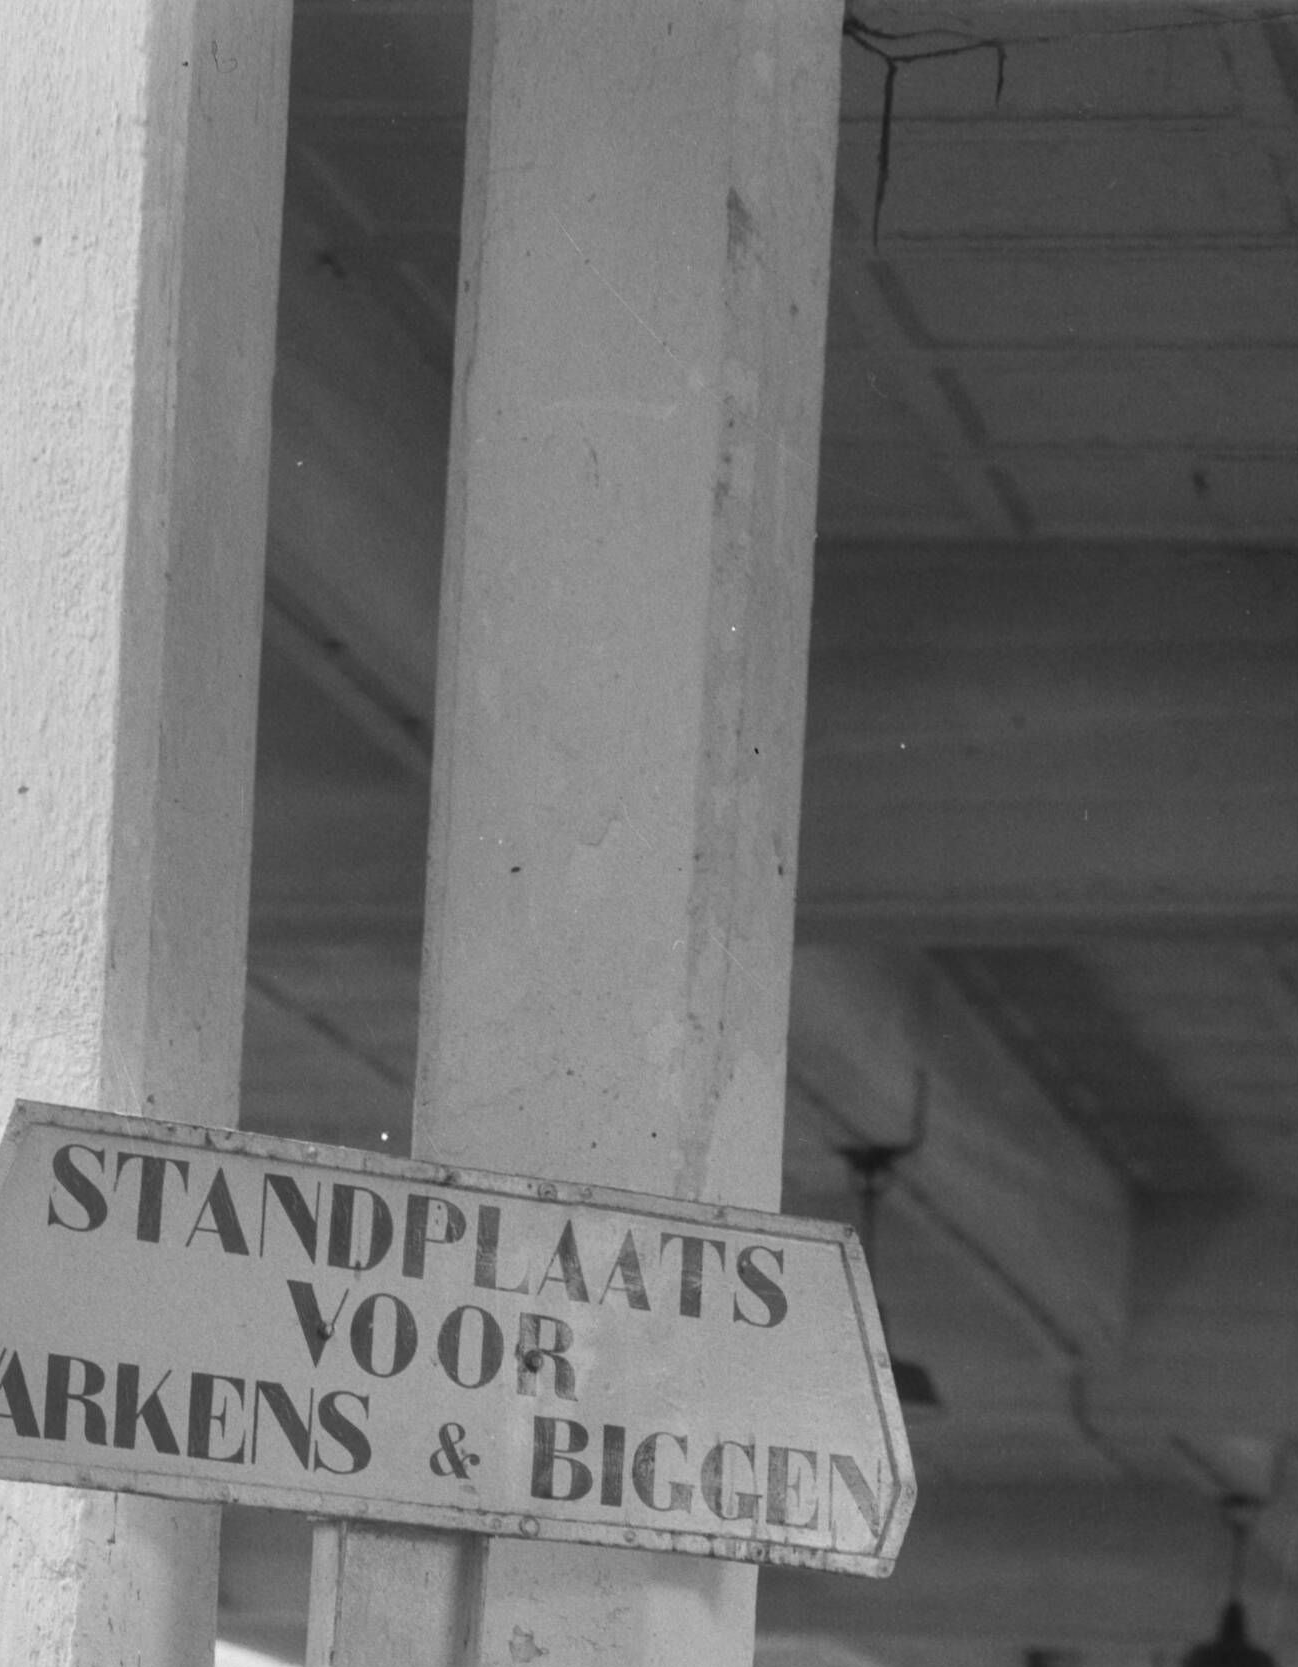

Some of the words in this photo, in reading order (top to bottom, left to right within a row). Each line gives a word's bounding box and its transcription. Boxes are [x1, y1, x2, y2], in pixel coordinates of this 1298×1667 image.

[47, 1143, 789, 1330] STANDPLAATS
[285, 1278, 579, 1403] VOOR
[428, 1421, 481, 1480] &
[529, 1414, 885, 1542] BIGGEN
